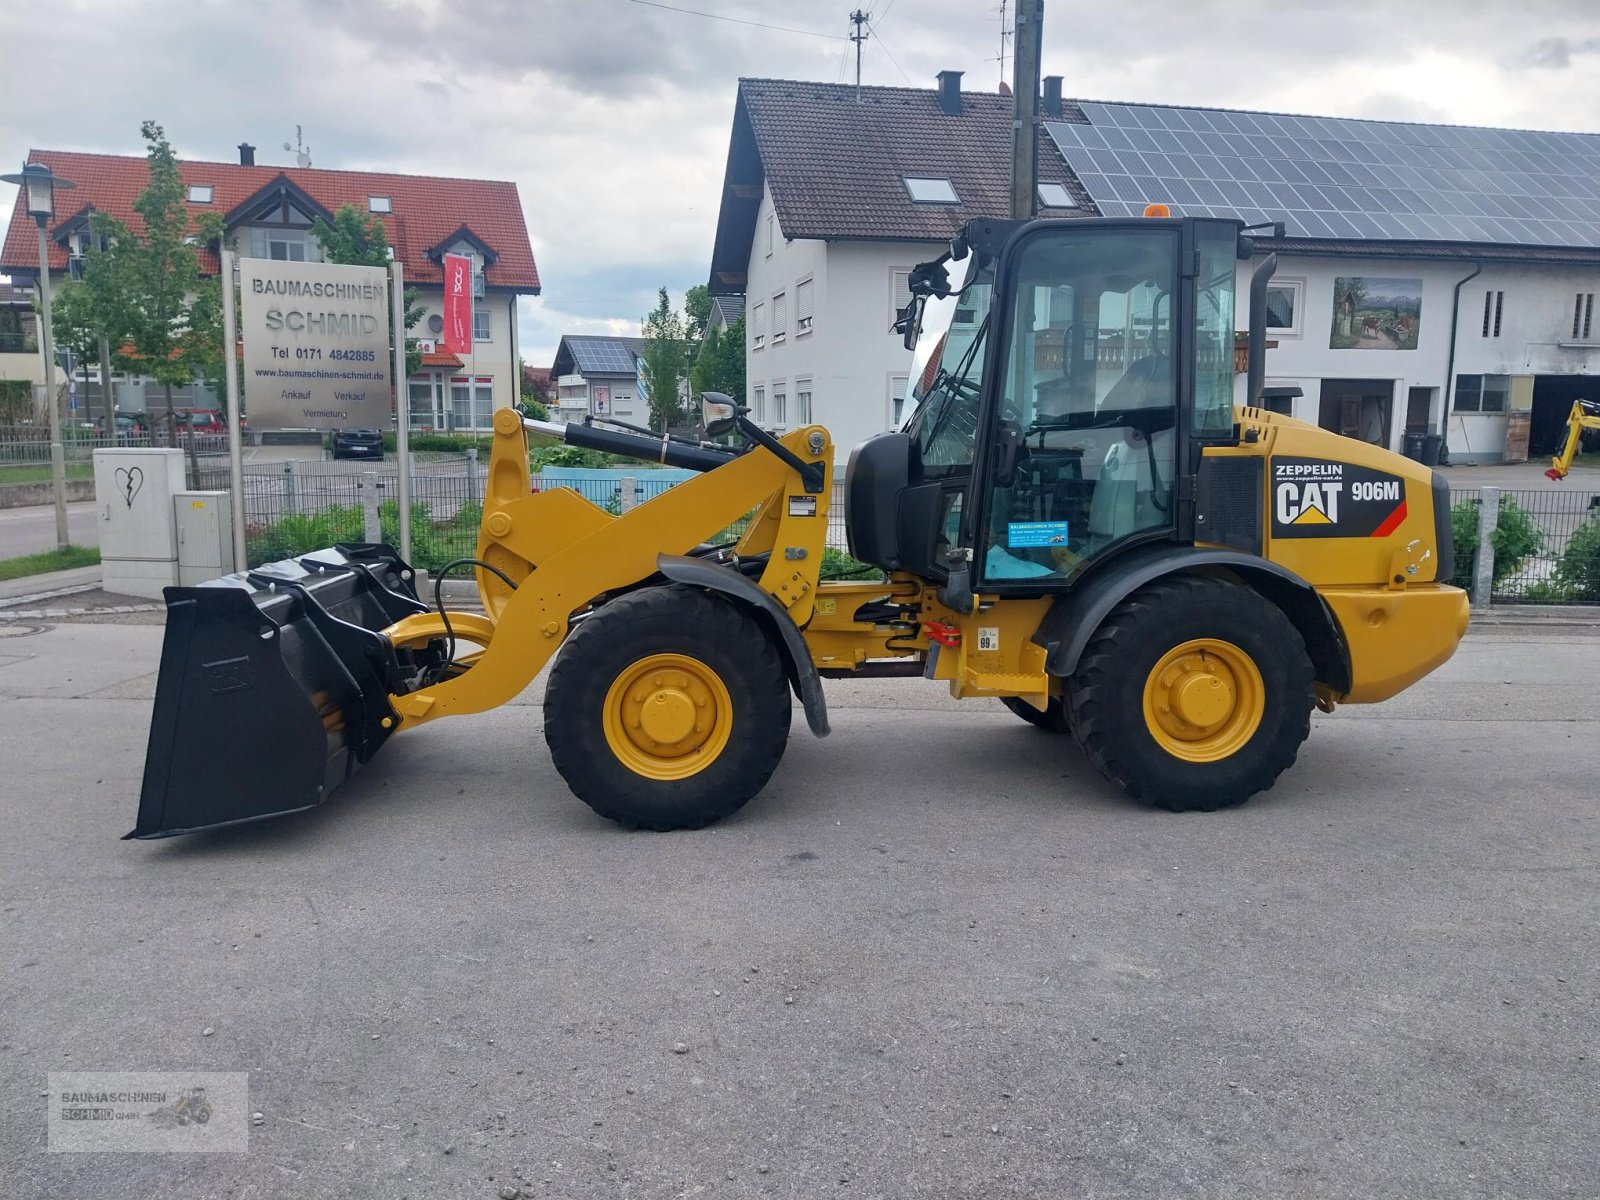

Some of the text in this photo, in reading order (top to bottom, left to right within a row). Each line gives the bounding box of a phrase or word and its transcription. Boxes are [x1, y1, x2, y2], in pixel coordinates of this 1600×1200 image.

[252, 278, 383, 300] BAUMASCHINEN
[265, 309, 378, 337] SCHMID
[271, 346, 375, 362] Tel 0171 4842885
[255, 368, 384, 381] www.baumaschinen-schmid.de
[281, 389, 366, 401] Ankauf Verkauf
[303, 408, 348, 420] Vermietung
[1276, 465, 1343, 475] ZEPPELIN
[1352, 481, 1399, 501] 906M
[1277, 482, 1343, 525] CAT
[980, 637, 990, 649] 99
